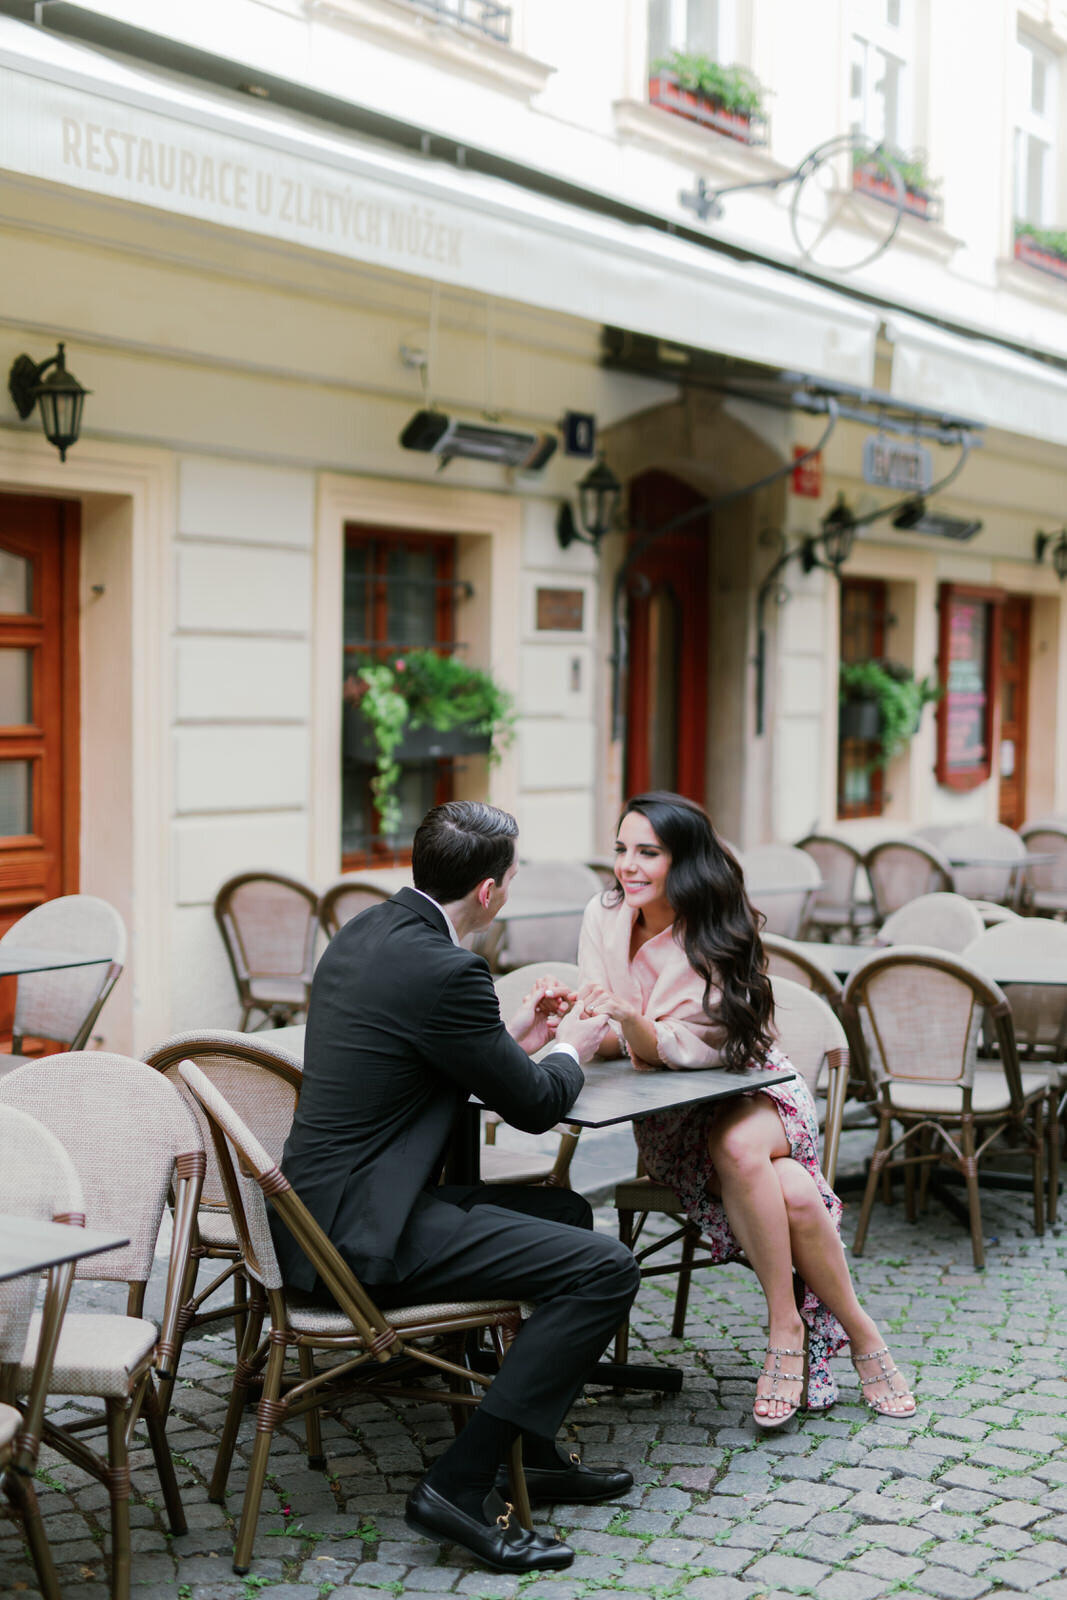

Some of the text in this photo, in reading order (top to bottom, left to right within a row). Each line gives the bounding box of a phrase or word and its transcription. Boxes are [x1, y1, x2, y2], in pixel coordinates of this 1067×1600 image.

[62, 116, 249, 210] RESTAURACE
[256, 169, 273, 216] U
[279, 176, 382, 246] ZLATÝCH
